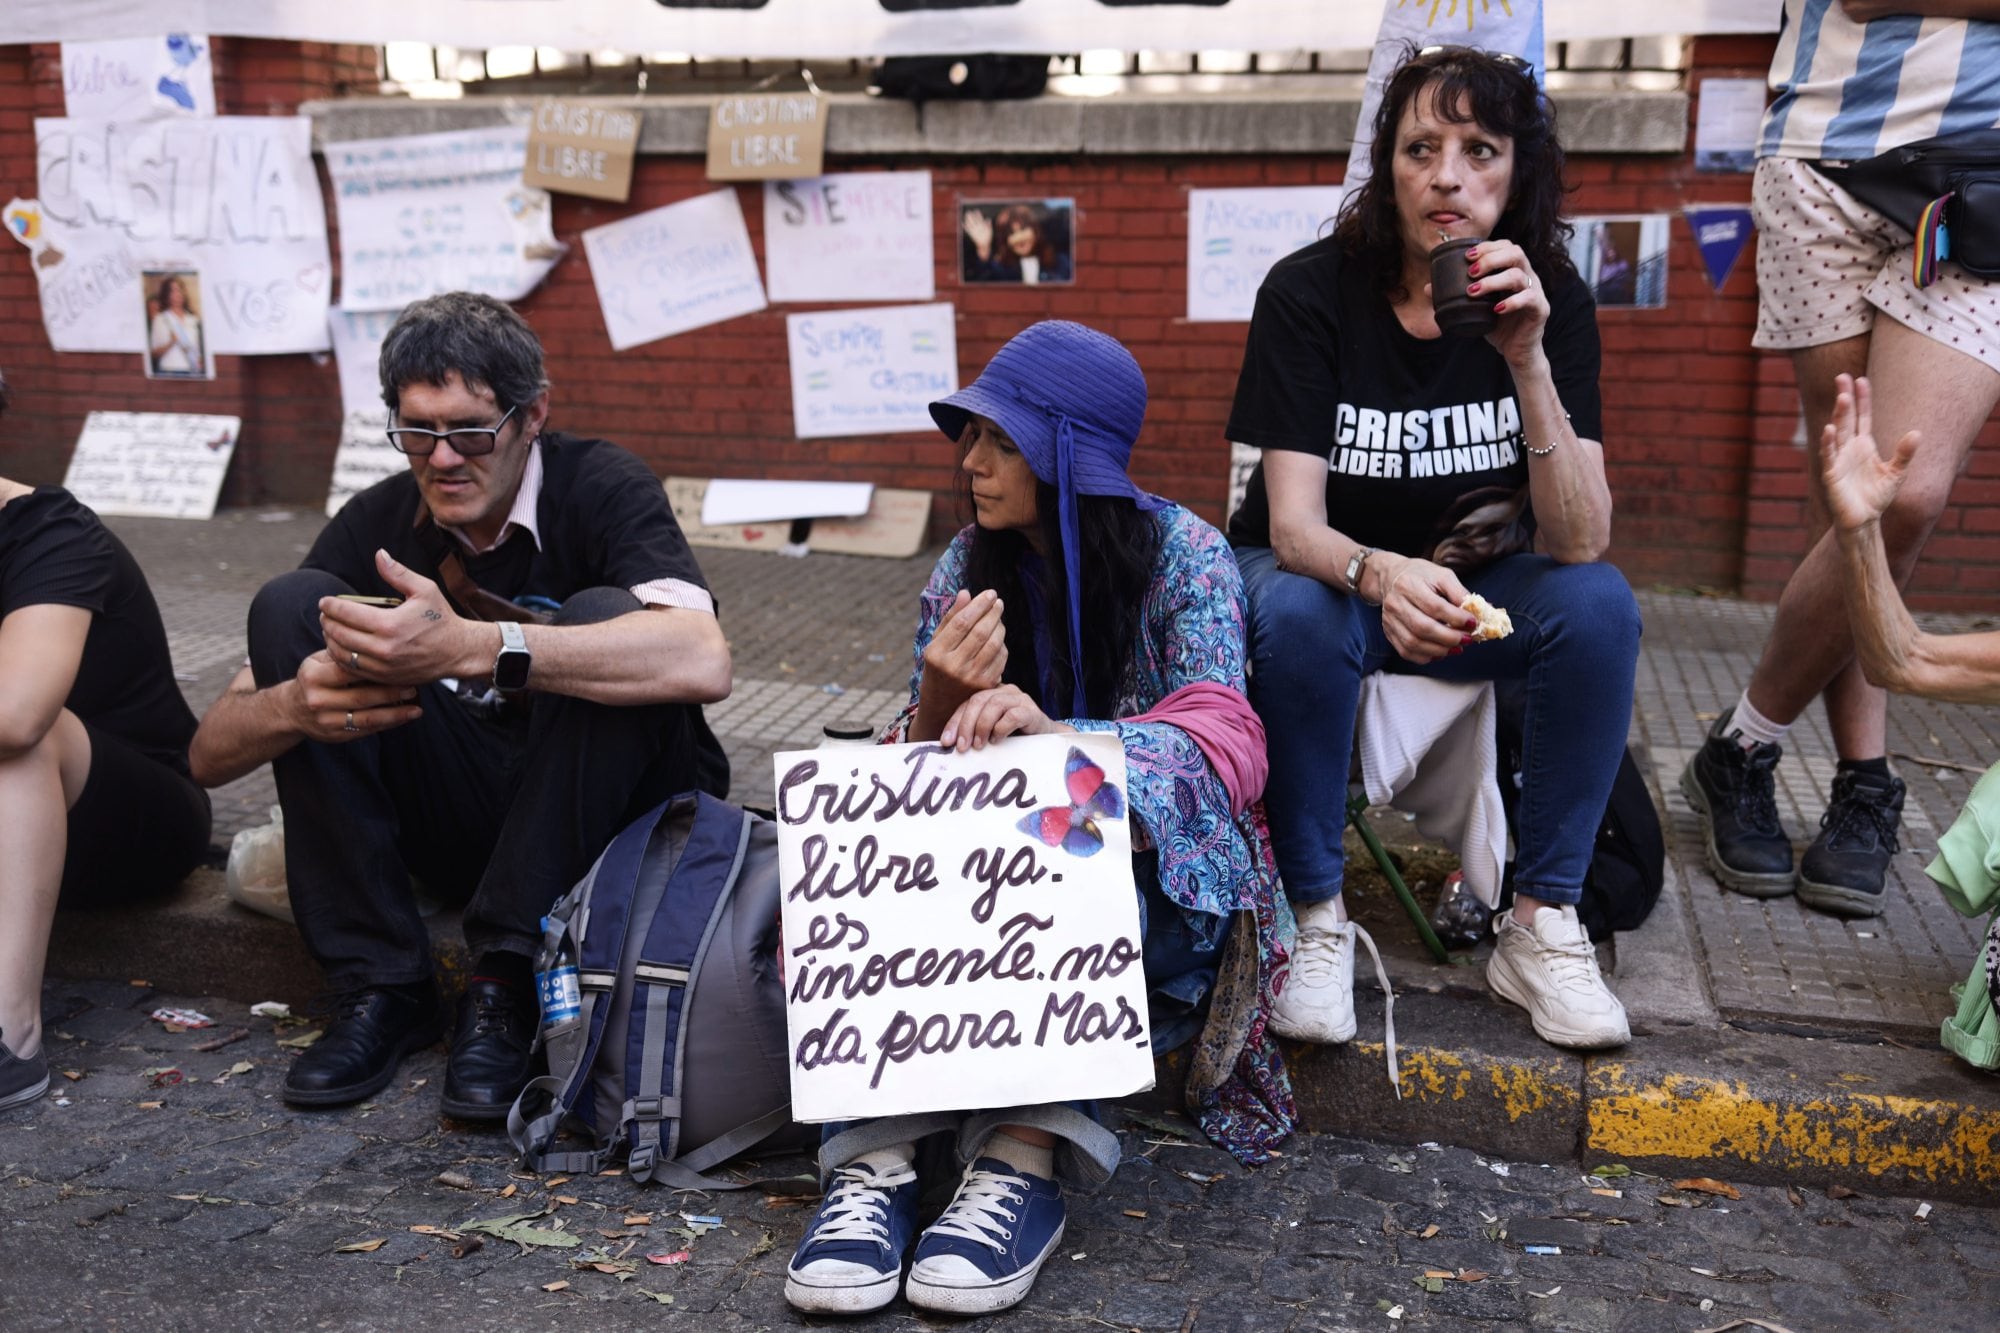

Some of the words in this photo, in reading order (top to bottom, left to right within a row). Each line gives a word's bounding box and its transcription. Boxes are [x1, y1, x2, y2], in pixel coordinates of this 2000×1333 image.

[68, 53, 139, 95] libre
[537, 98, 637, 140] CRISTINA
[717, 97, 817, 129] CRISTINA
[537, 142, 608, 182] LIBRE
[730, 134, 800, 167] LIBRE
[38, 122, 306, 246] CRISTINA
[775, 179, 923, 228] SIEMPRE
[1333, 396, 1522, 452] CRISTINA
[1328, 446, 1403, 479] LIDER
[778, 745, 1038, 826] Cristina
[787, 834, 939, 903] libre
[960, 845, 1063, 924] ya.
[792, 911, 870, 957] es
[1050, 936, 1142, 981] no
[795, 1007, 867, 1071] da
[868, 1009, 1022, 1090] para
